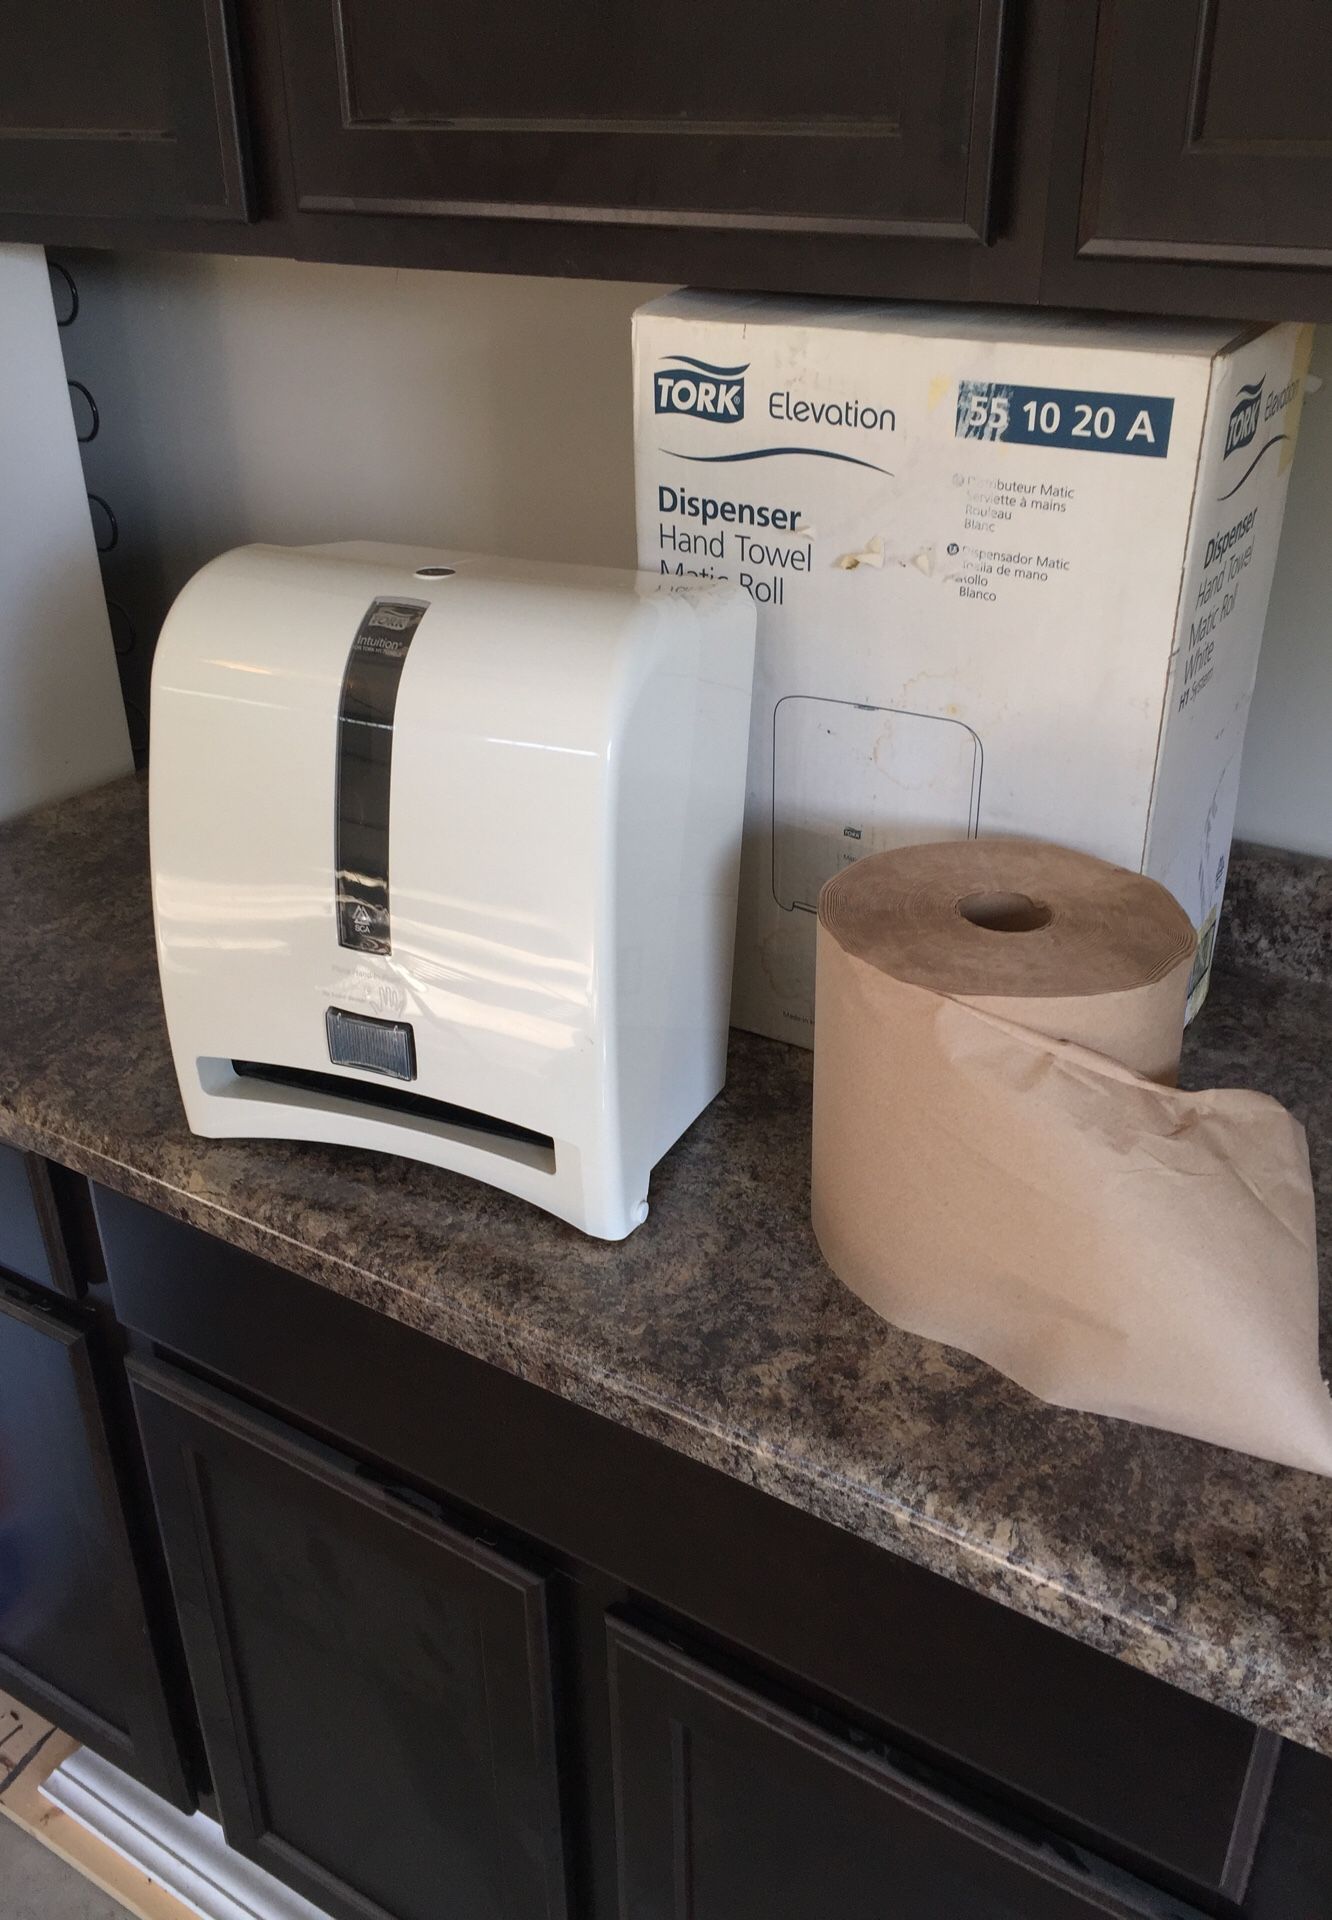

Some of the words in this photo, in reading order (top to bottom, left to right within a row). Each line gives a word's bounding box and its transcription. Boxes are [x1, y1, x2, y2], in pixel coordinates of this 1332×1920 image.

[657, 377, 742, 416] TORK
[768, 391, 896, 431] Elevation
[968, 394, 1010, 430] 55
[1022, 400, 1061, 434] 10
[1071, 404, 1116, 439] 20
[1125, 410, 1156, 443] A
[1226, 395, 1260, 452] TORK
[658, 486, 802, 531] Dispenser
[1019, 496, 1027, 508] à
[1030, 499, 1067, 513] mains
[1039, 483, 1075, 499] Matic
[659, 523, 724, 559] Hand
[734, 534, 812, 572] Towel
[964, 518, 996, 533] Blanc
[1203, 506, 1259, 570] Dispenser
[660, 559, 729, 581] Mti
[739, 572, 784, 605] Roll
[996, 565, 1011, 576] de
[1014, 568, 1049, 582] mano
[1036, 555, 1071, 571] Matic
[1195, 560, 1228, 611] Hand
[1227, 534, 1256, 583] Towel
[959, 586, 997, 602] Blanco
[357, 634, 400, 651] Intuition
[1188, 604, 1220, 652] Matic
[1184, 640, 1215, 686] White
[354, 924, 371, 934] SCA
